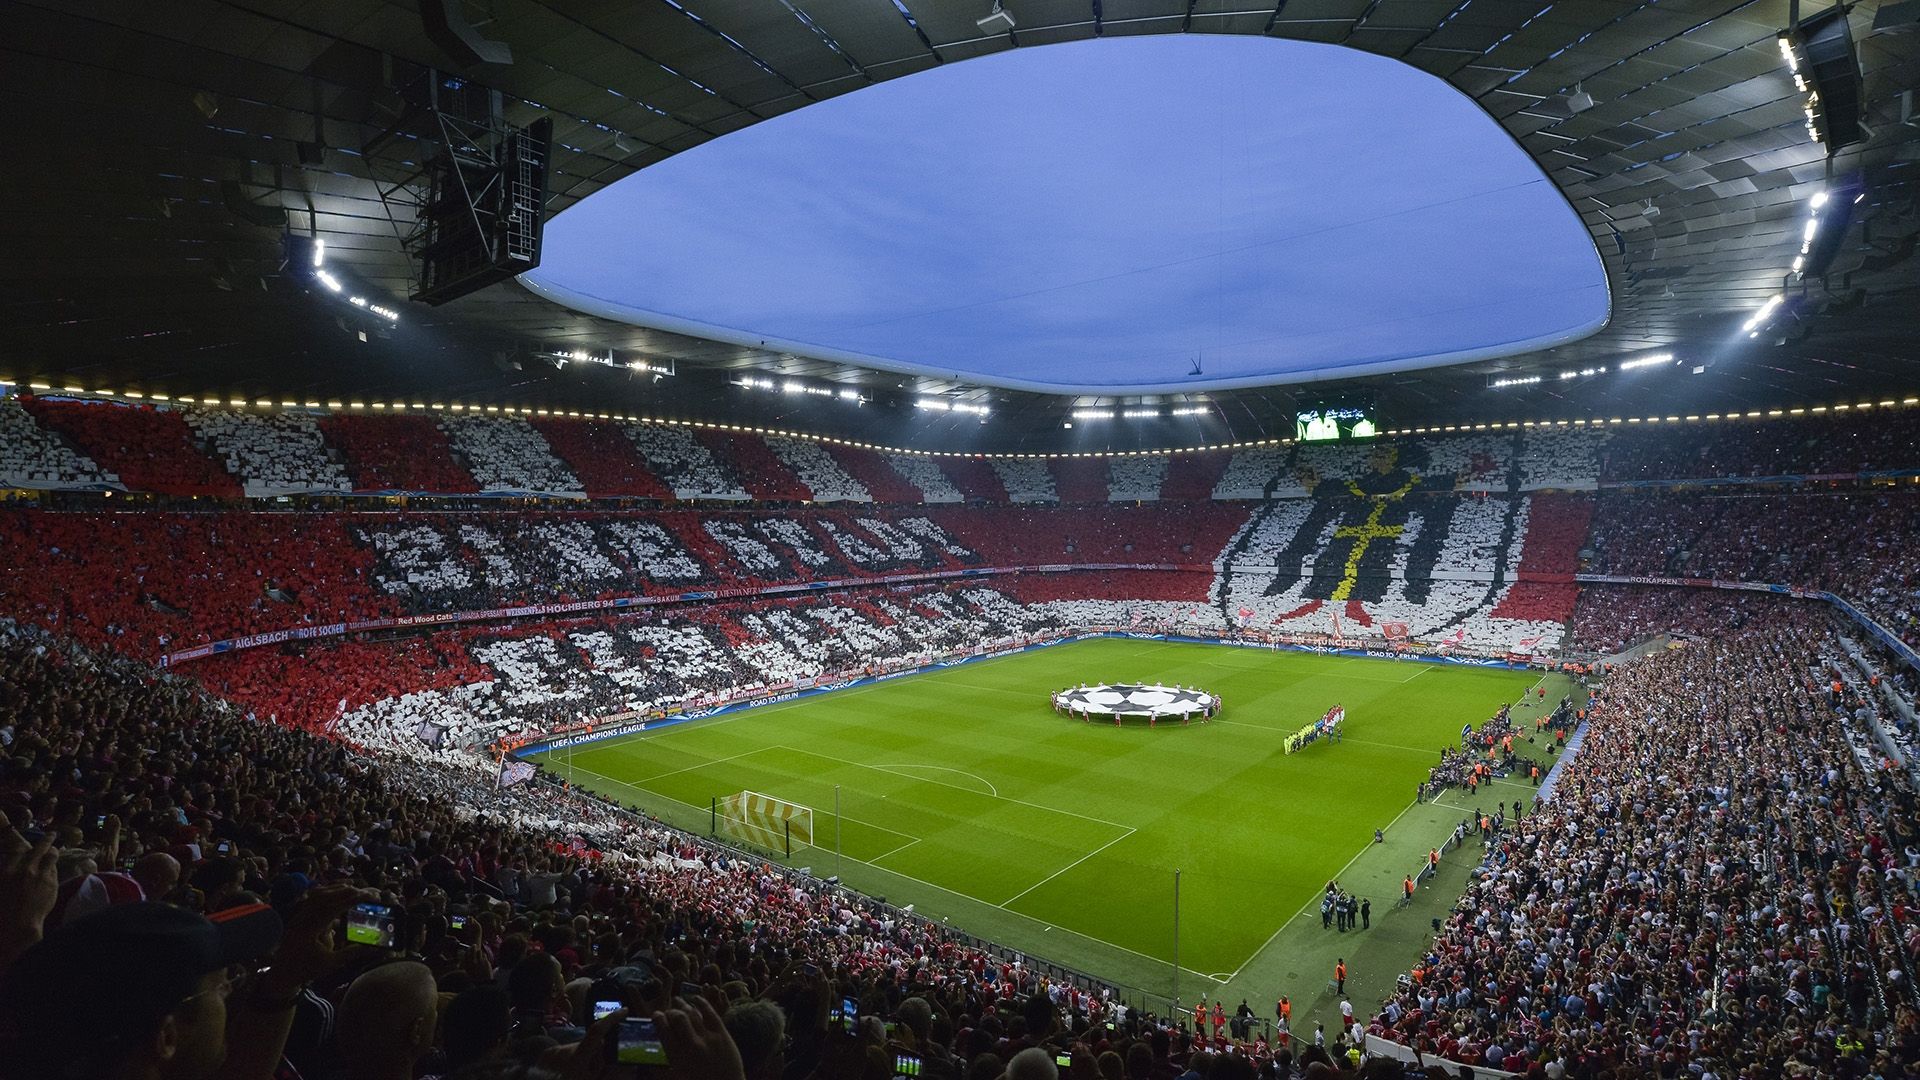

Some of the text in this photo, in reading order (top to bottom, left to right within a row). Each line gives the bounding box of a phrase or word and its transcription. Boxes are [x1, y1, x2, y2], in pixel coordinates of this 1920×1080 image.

[398, 612, 453, 625] Red Wood Cats
[235, 631, 289, 649] AIGLSBACH
[1366, 650, 1385, 658] ROAD
[696, 694, 730, 707] ZIERIG
[749, 691, 799, 708] ROAD TO BERLIN
[552, 723, 646, 748] UEFA CHAMPIONS LEAGUE
